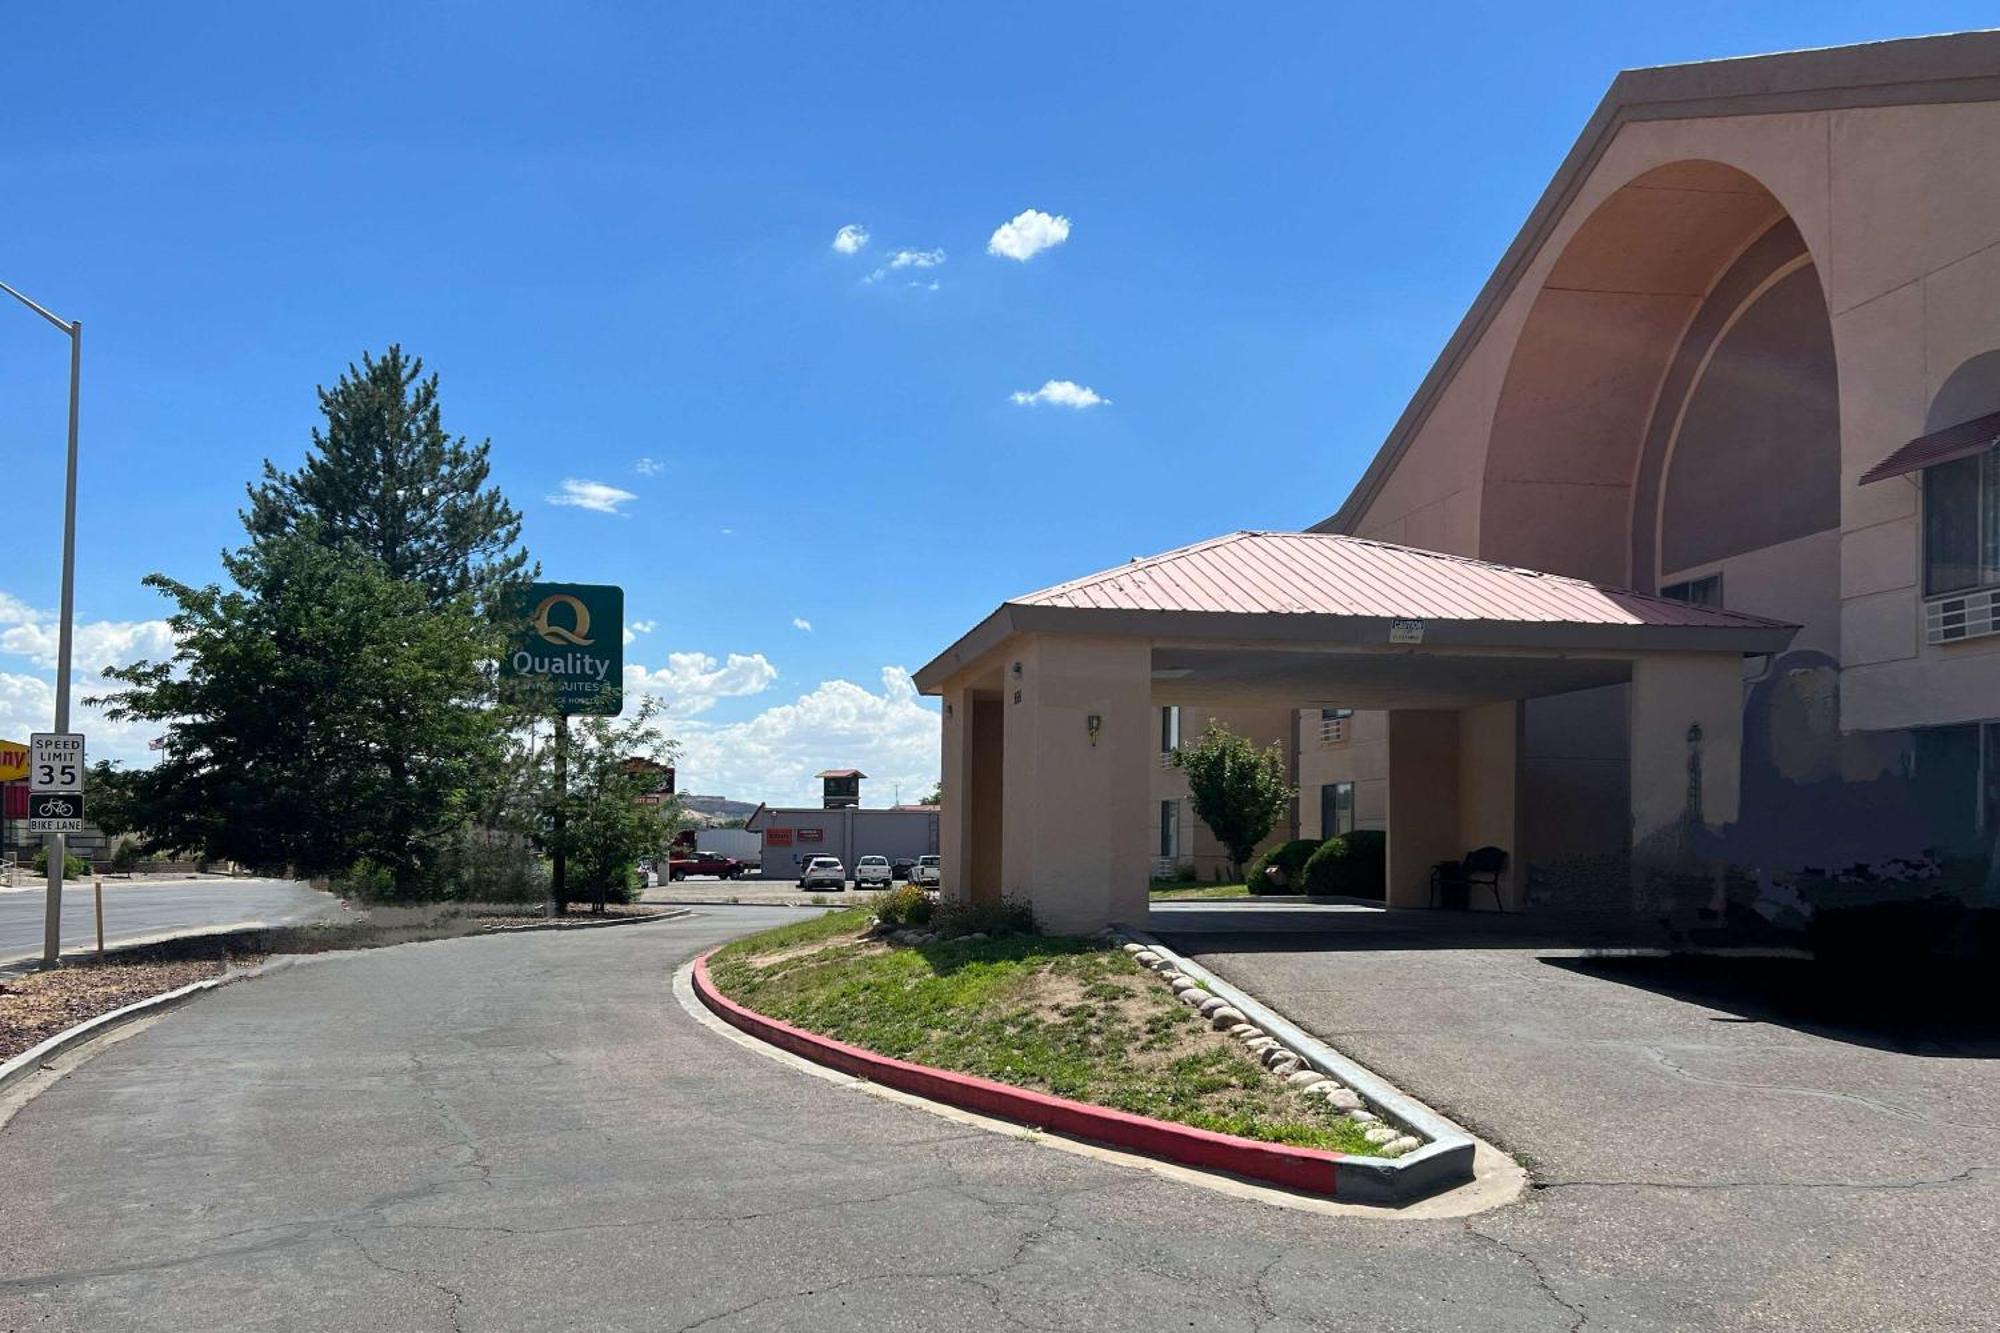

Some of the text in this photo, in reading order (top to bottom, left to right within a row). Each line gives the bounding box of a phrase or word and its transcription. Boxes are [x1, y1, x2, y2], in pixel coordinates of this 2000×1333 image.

[512, 651, 610, 680] Quality
[36, 739, 81, 749] SPEED
[0, 750, 26, 769] ny
[40, 752, 75, 762] LIMIT
[38, 765, 76, 786] 35
[31, 820, 82, 831] BIKE LANE
